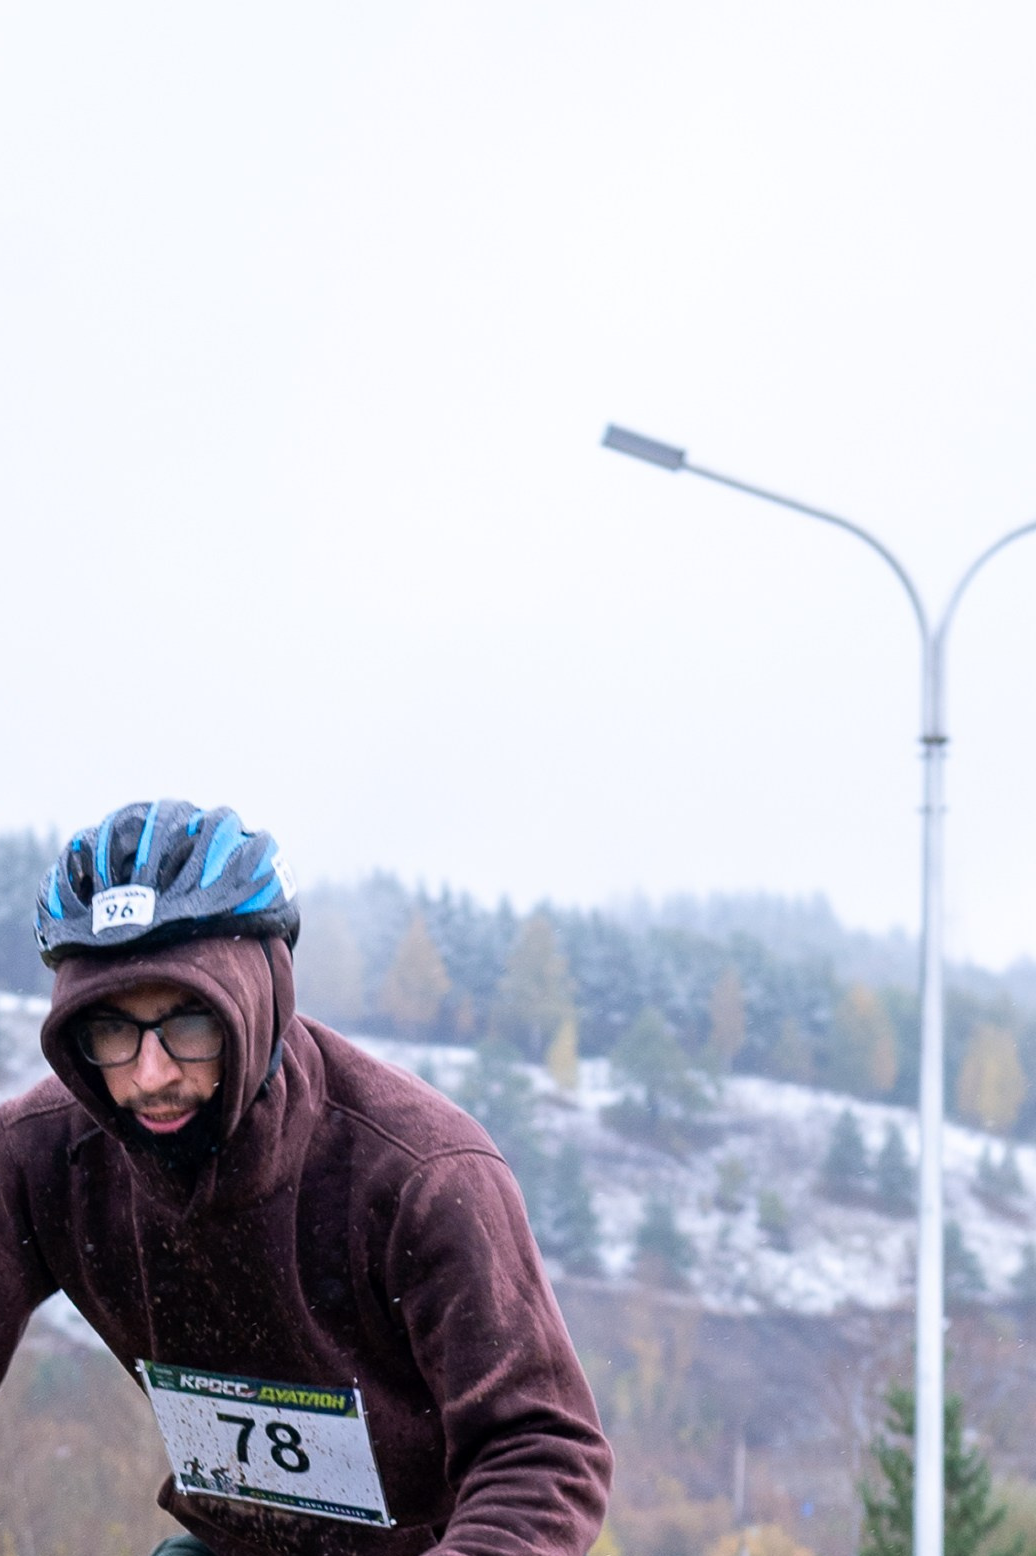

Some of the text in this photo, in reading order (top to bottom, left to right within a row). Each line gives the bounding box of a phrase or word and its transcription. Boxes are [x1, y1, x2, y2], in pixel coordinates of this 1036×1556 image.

[106, 901, 133, 921] 96
[180, 1373, 252, 1398] КРОСС
[257, 1386, 346, 1410] ДУАТЛОН
[216, 1412, 310, 1474] 78
